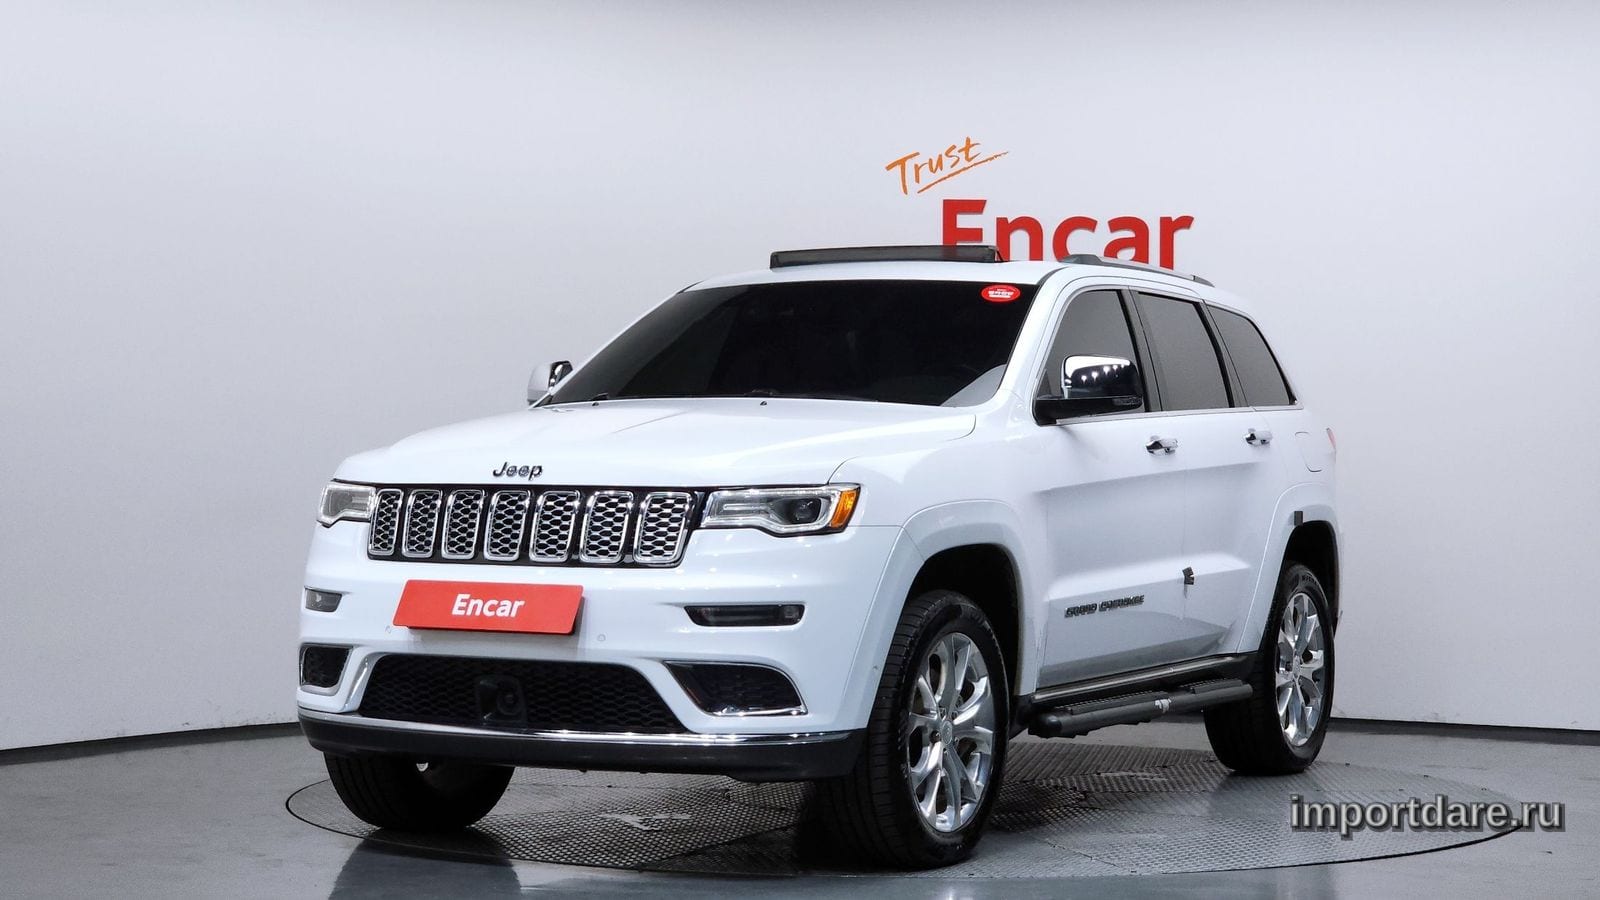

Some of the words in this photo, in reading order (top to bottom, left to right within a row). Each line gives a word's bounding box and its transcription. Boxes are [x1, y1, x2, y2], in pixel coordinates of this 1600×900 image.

[885, 136, 982, 195] Trust
[942, 198, 1195, 270] Encar
[492, 461, 544, 481] Jeep
[451, 593, 525, 618] Encar
